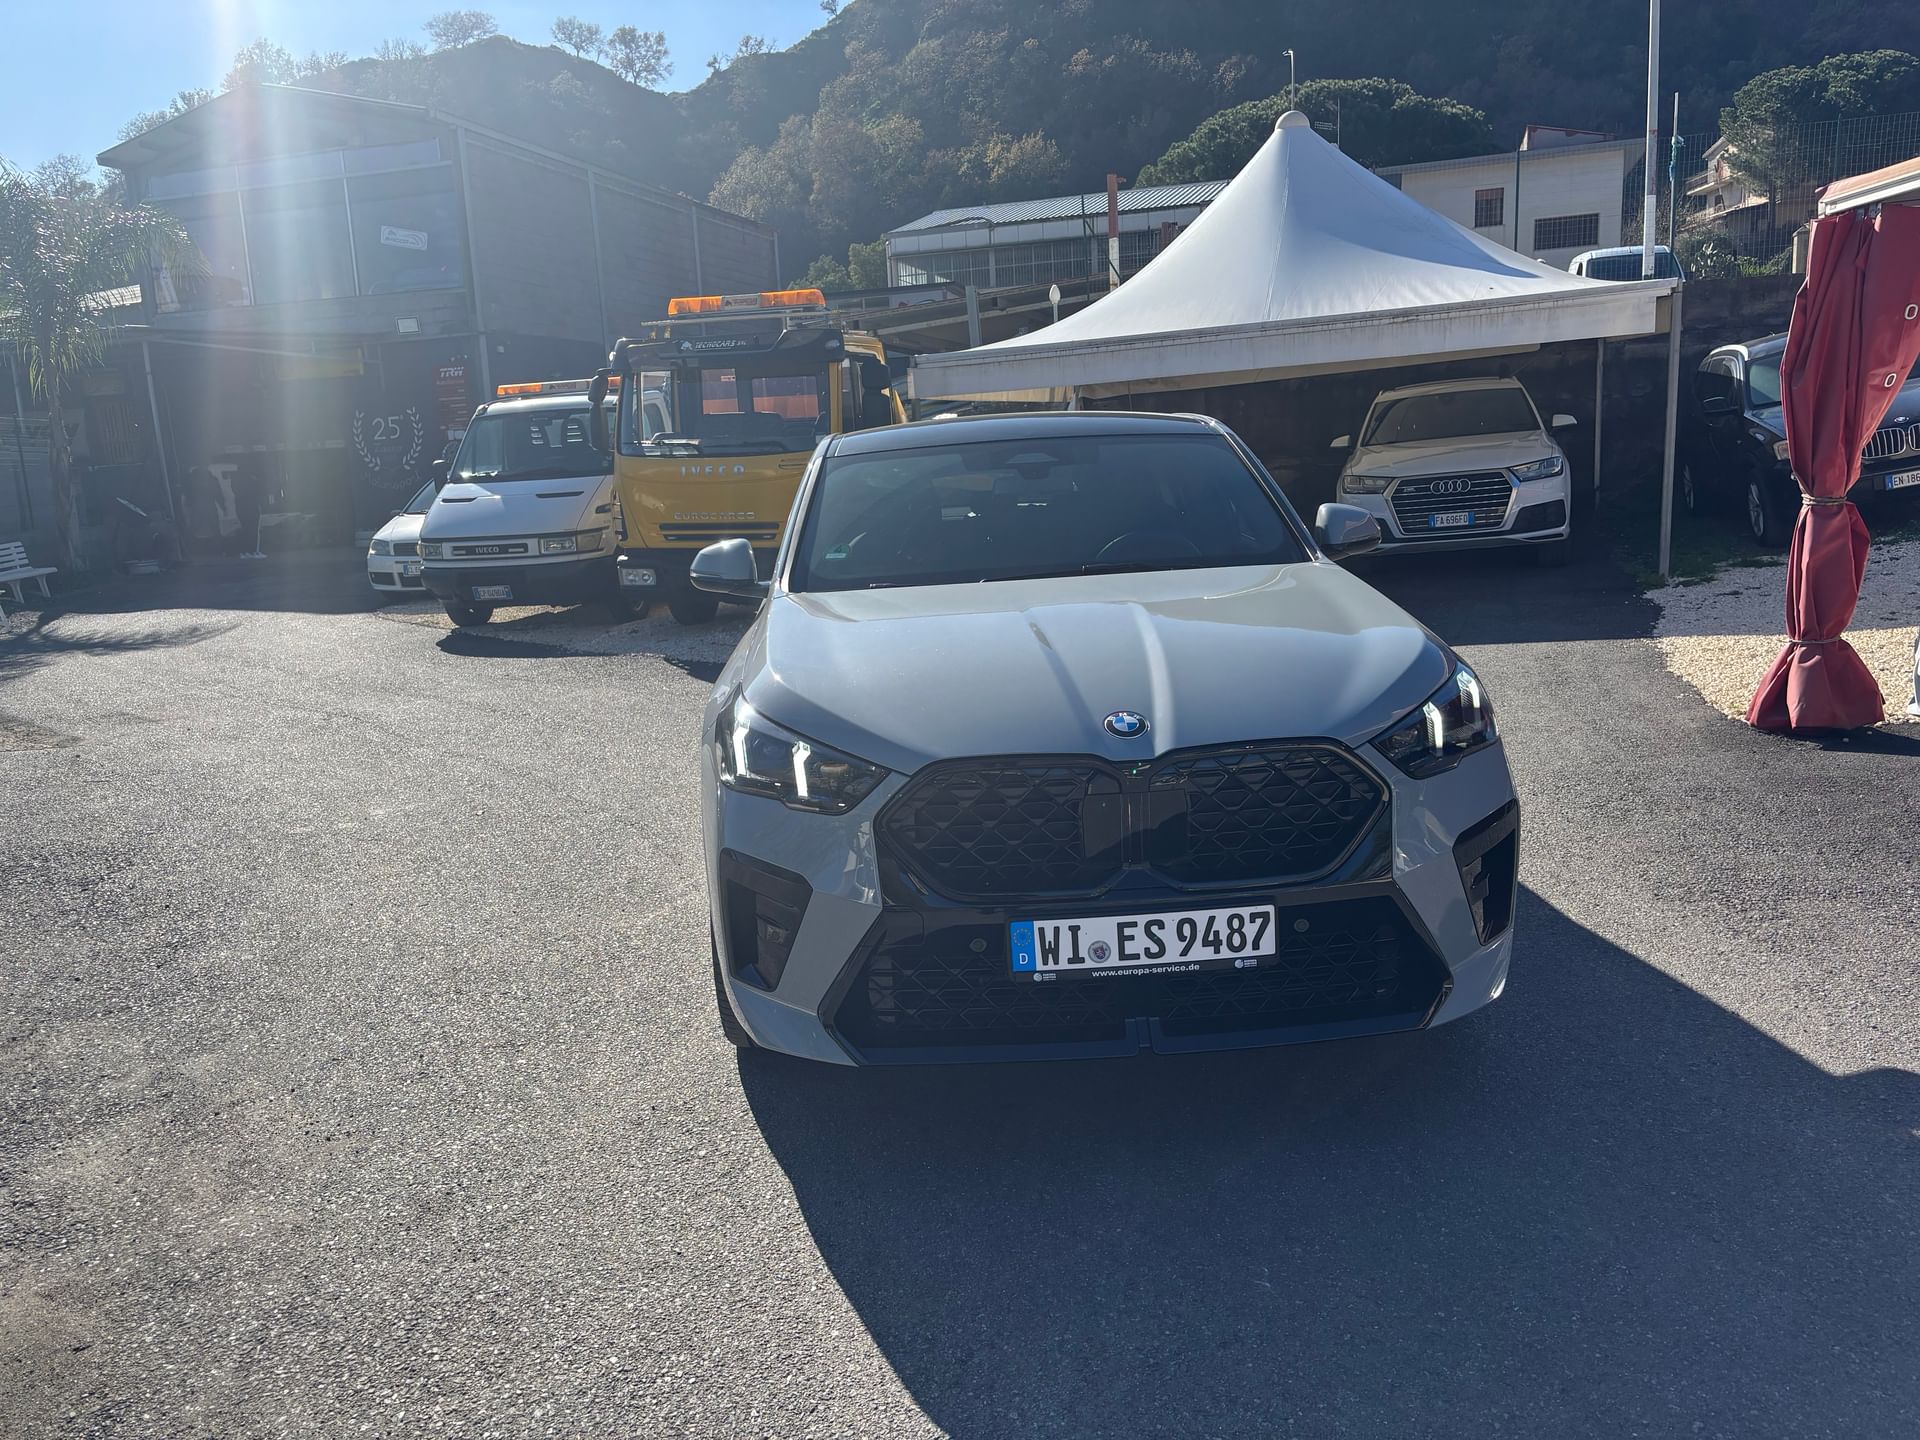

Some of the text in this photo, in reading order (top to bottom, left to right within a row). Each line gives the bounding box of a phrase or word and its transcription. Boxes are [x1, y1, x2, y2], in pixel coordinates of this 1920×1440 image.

[681, 463, 745, 477] IVECO
[1894, 476, 1904, 486] EN
[1435, 516, 1444, 525] FA
[475, 546, 500, 554] IVECO
[1037, 910, 1272, 966] WI ES 9487
[1019, 953, 1029, 965] D
[1091, 963, 1200, 978] www.europa-service.de
